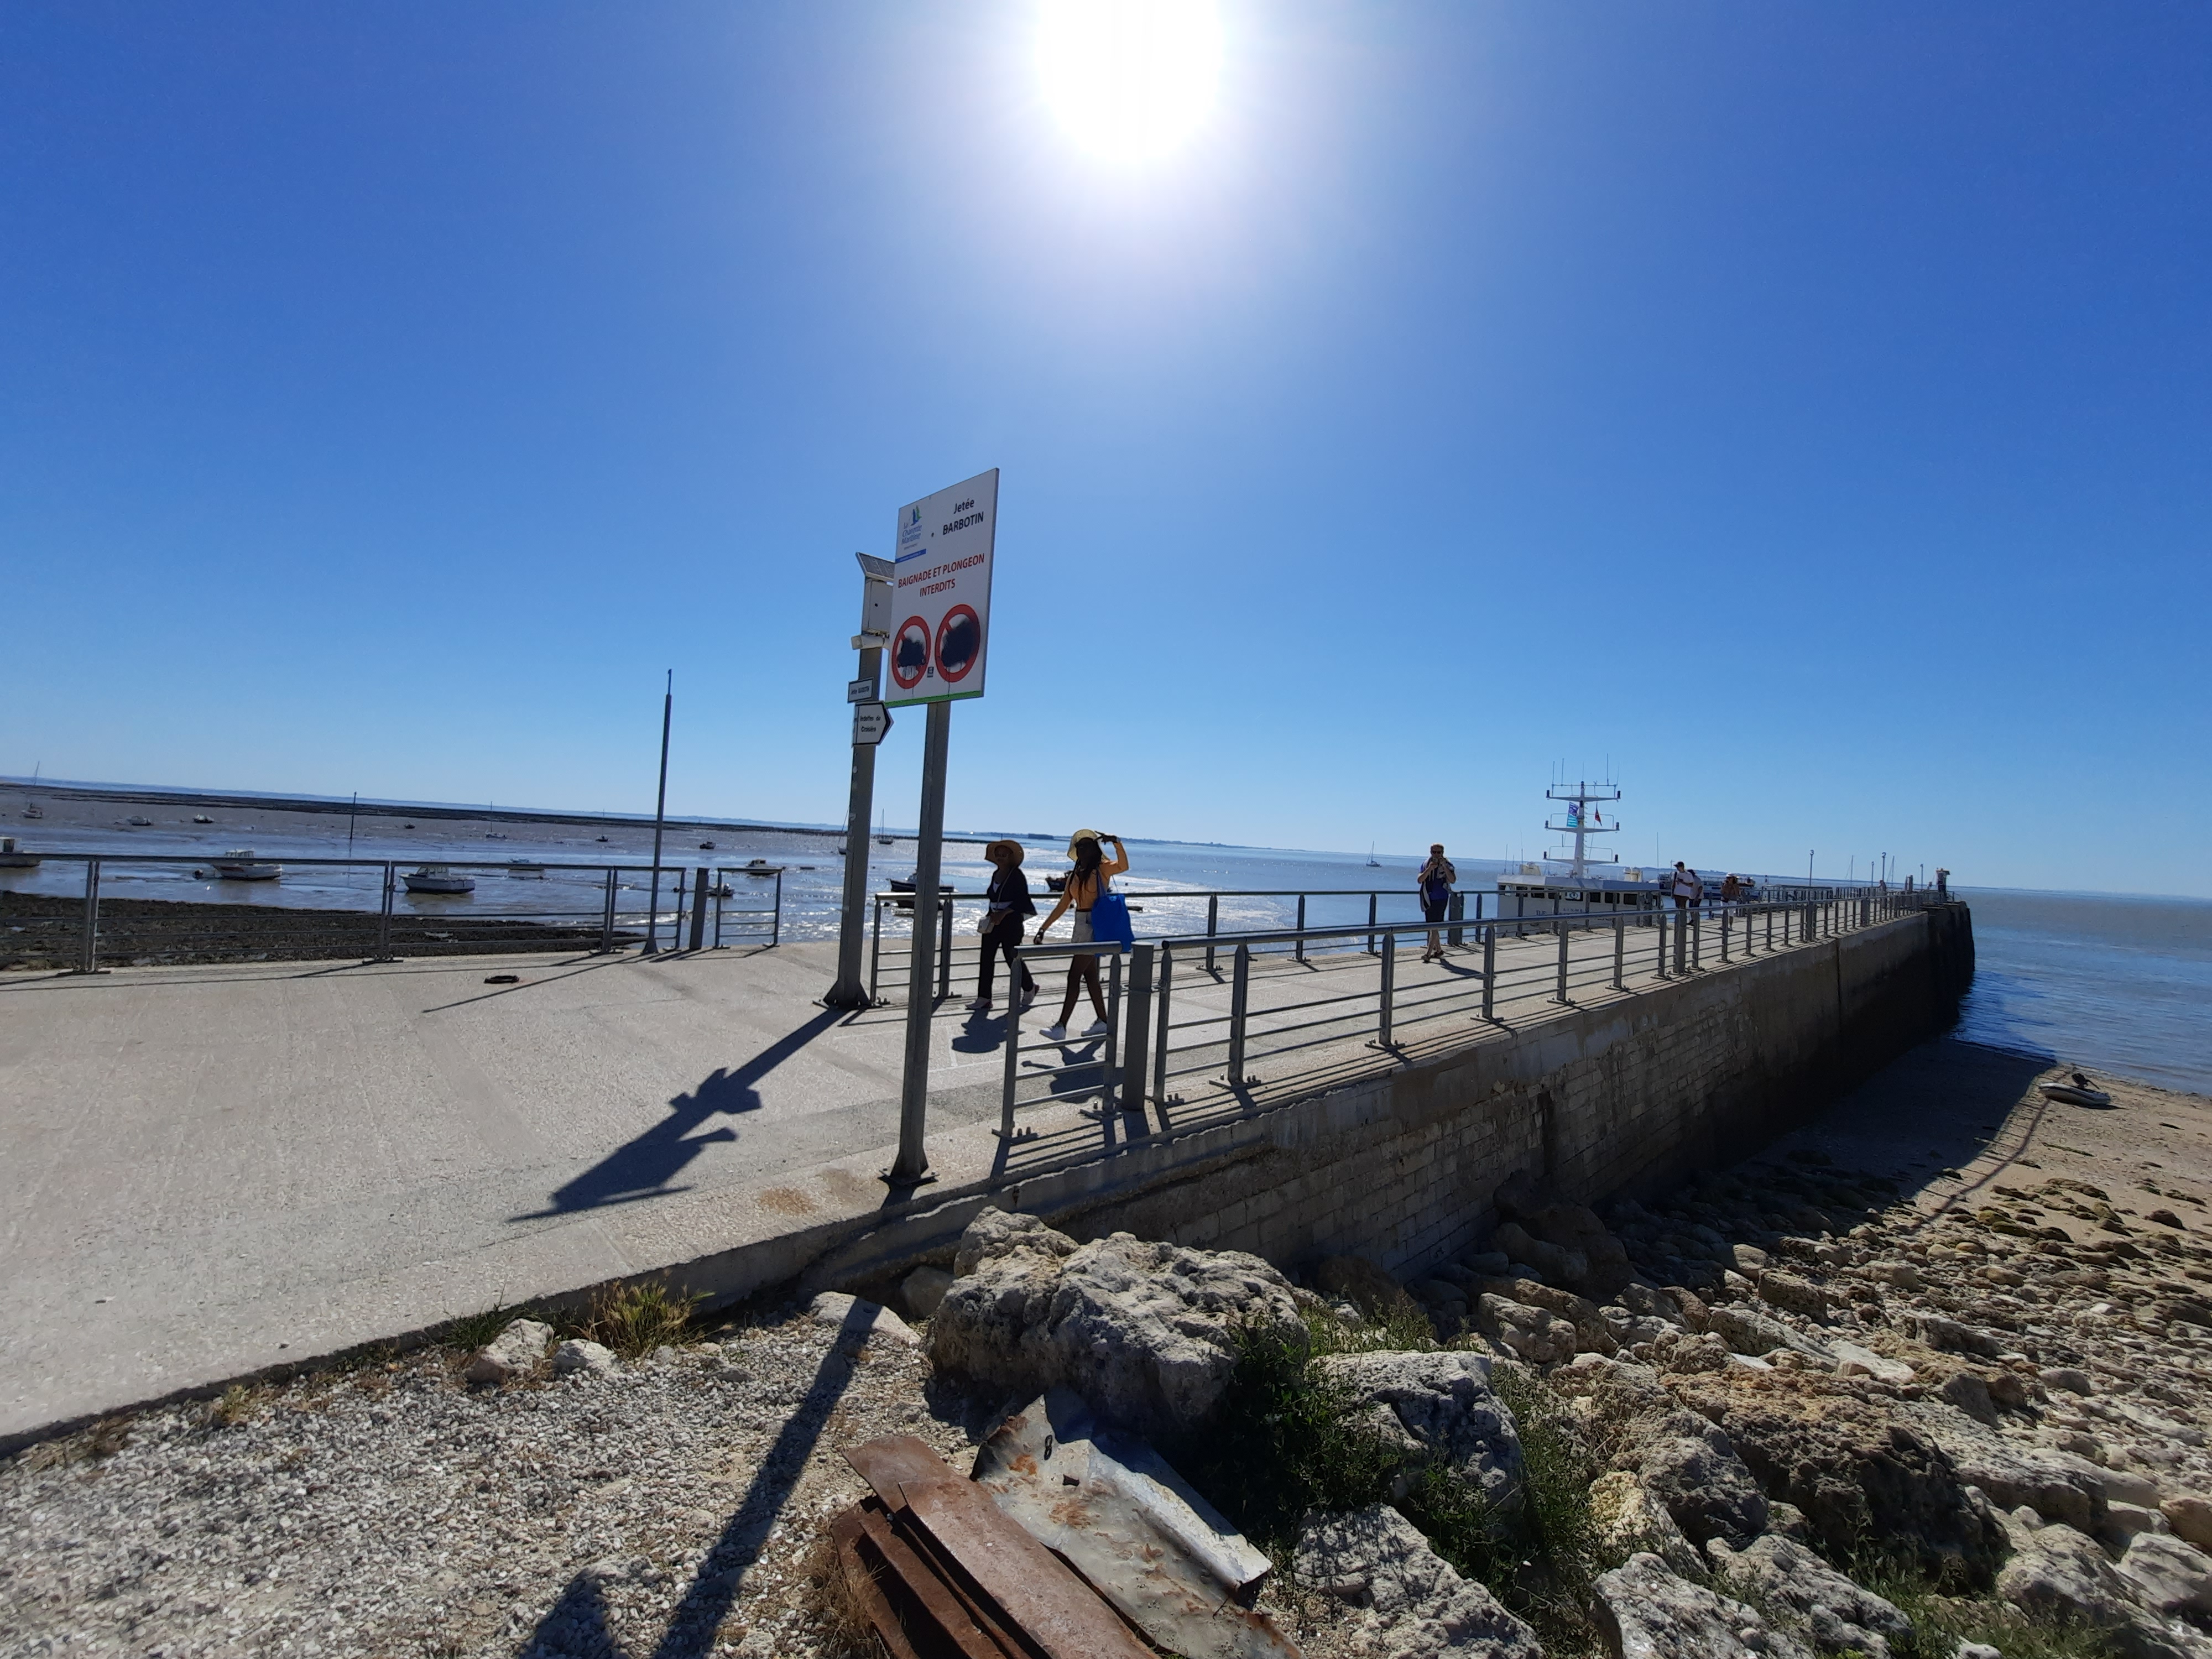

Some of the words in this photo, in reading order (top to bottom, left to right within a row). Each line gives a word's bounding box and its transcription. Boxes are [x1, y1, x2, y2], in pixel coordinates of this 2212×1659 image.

[953, 498, 974, 514] Jetée
[943, 512, 984, 535] BARBOTIN
[898, 570, 931, 588] BAIGNADE
[933, 566, 941, 577] ET
[943, 553, 984, 575] PLONGEON
[920, 578, 956, 597] INTERDITS
